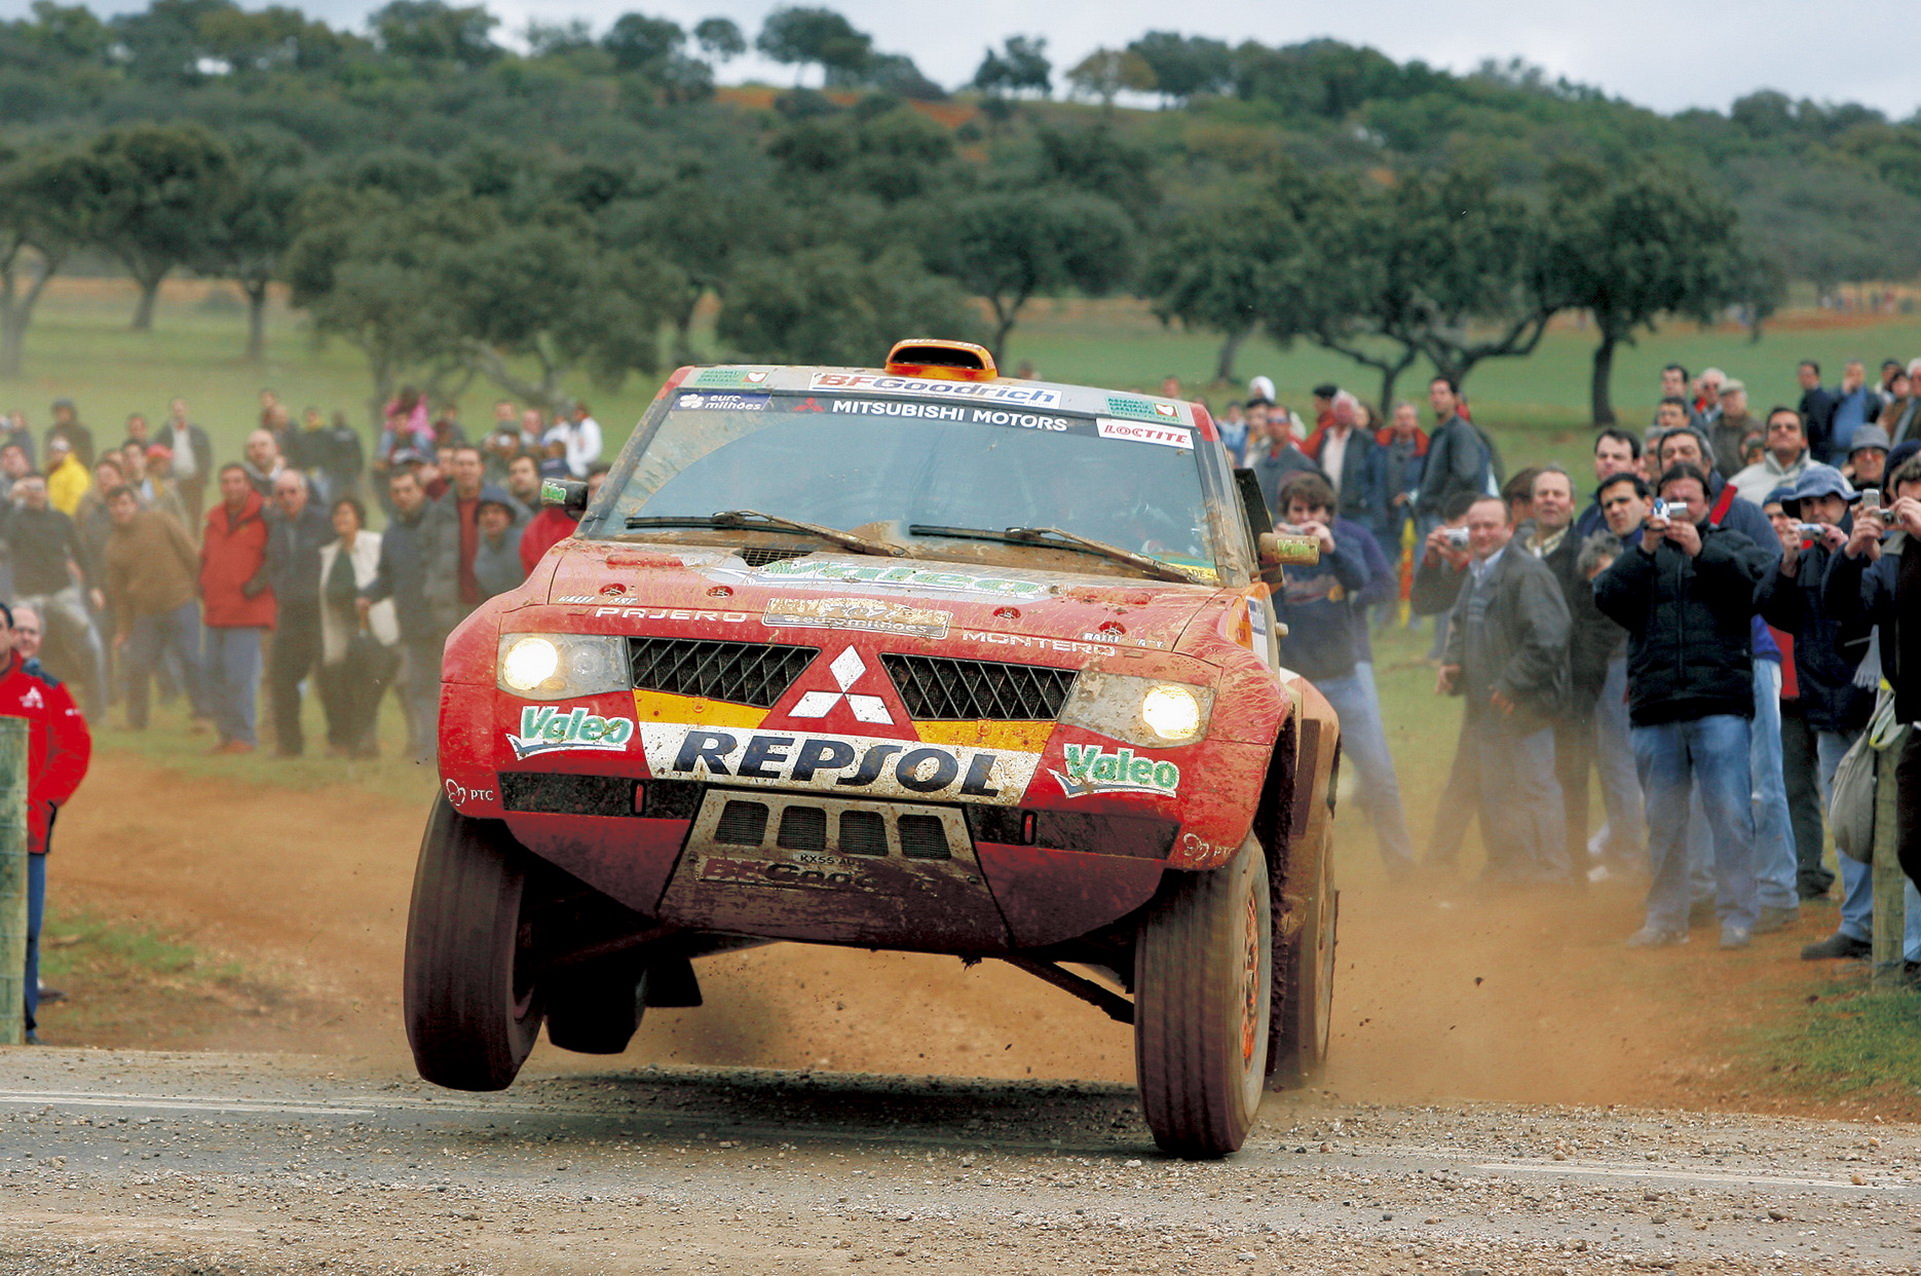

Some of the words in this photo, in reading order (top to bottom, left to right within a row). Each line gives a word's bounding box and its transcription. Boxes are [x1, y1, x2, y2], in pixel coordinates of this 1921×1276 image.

[818, 372, 1055, 403] BFGoodrich
[832, 400, 965, 420] MITSUBISHI
[972, 409, 1068, 432] MOTORS
[1104, 425, 1188, 443] LOCTITE
[594, 607, 748, 623] PAJERO
[962, 631, 1116, 657] MONTERO
[520, 706, 634, 745] Valeo
[672, 730, 1001, 797] REPSOL
[1063, 743, 1180, 790] Valeo
[470, 790, 494, 801] PTC
